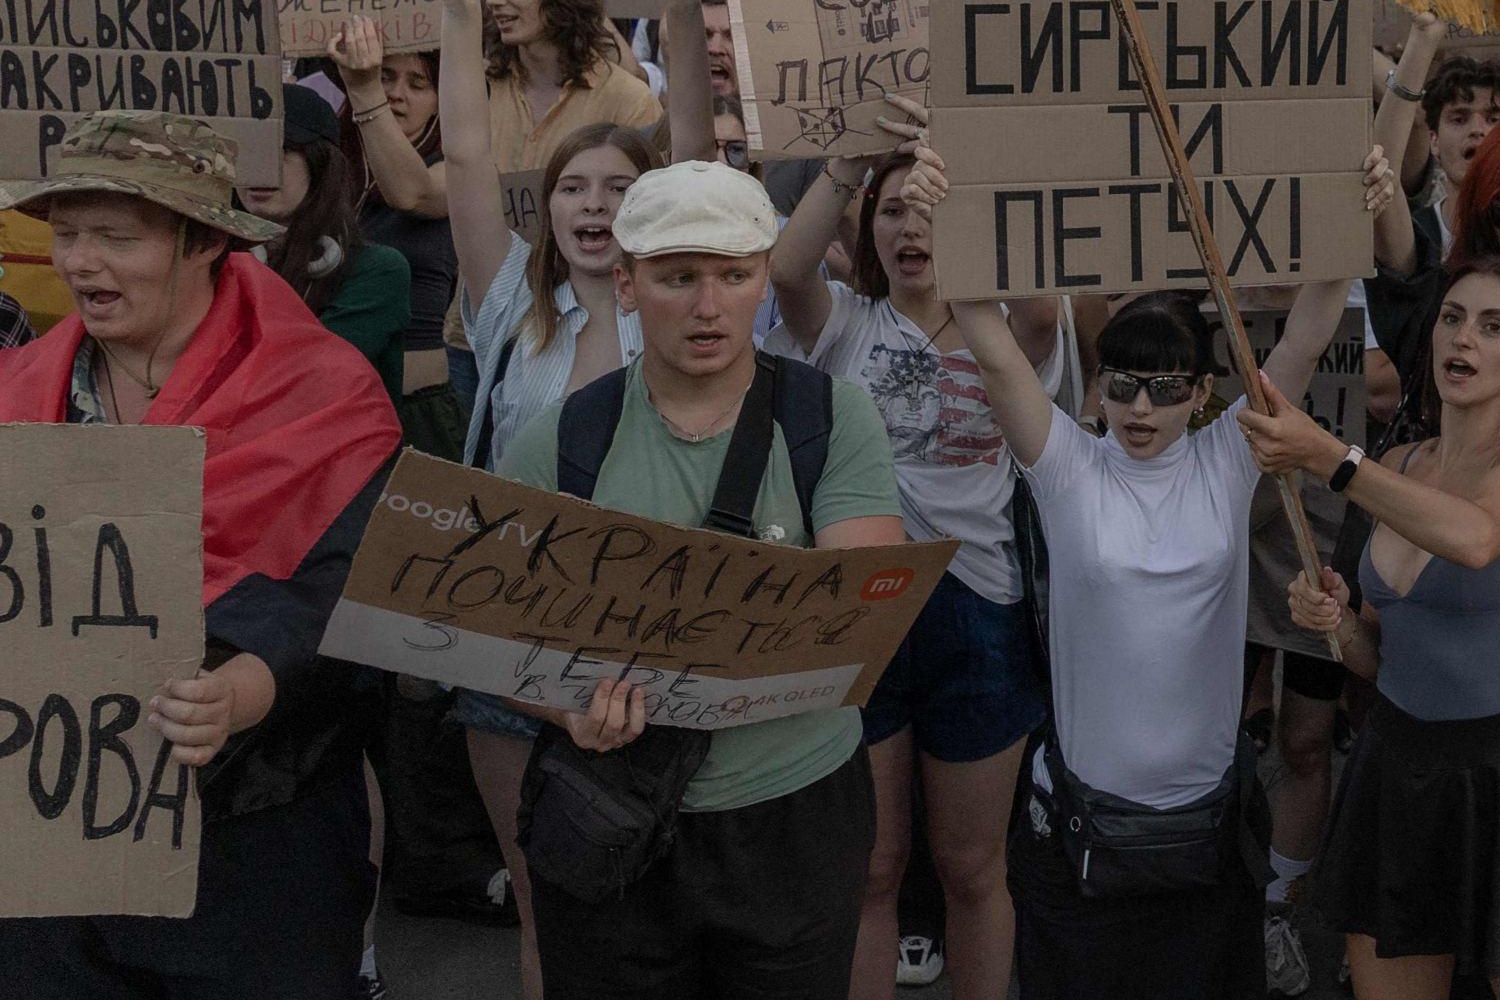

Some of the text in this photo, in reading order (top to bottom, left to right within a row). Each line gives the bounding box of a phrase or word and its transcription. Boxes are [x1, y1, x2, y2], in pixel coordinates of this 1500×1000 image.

[994, 177, 1302, 291] ПЕТУХ!
[444, 494, 844, 603] УКРАЇНА
[513, 630, 726, 698] ТЕБЕ
[783, 684, 836, 703] QLED
